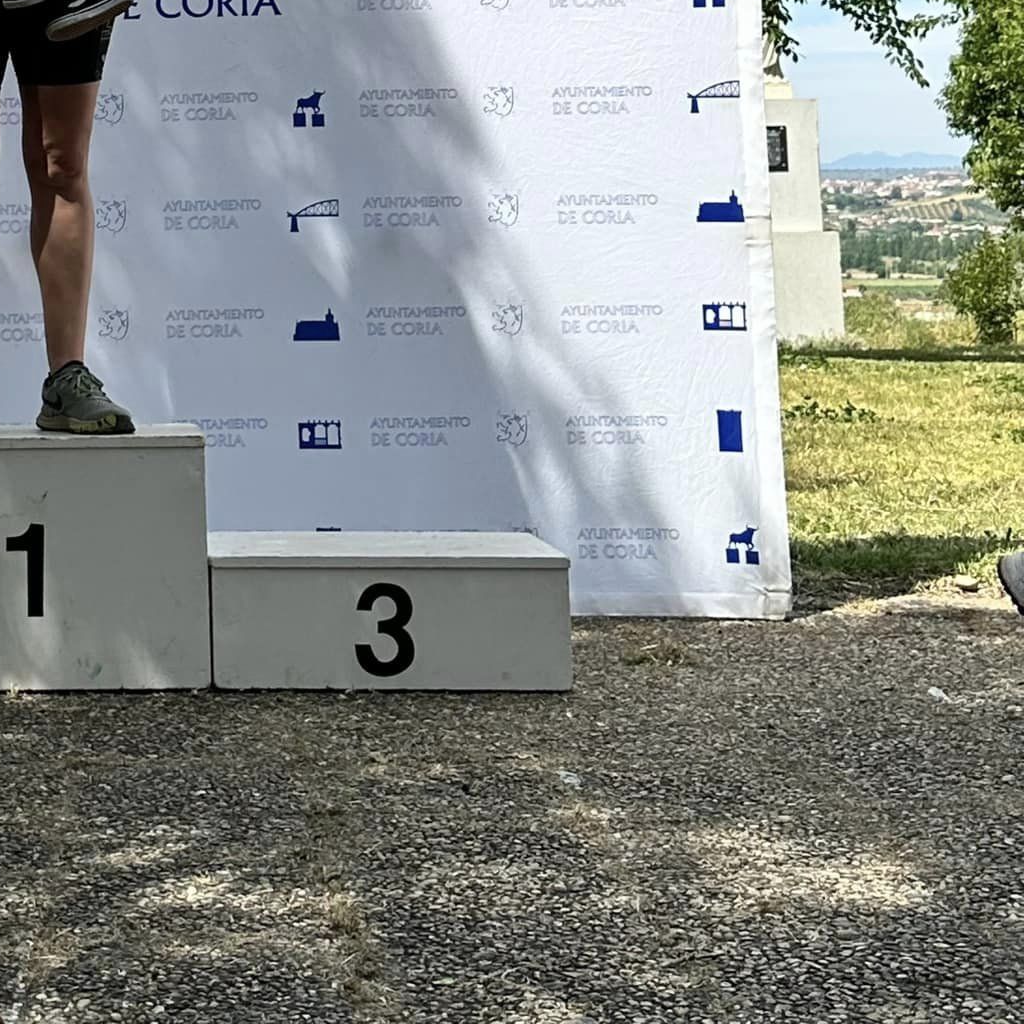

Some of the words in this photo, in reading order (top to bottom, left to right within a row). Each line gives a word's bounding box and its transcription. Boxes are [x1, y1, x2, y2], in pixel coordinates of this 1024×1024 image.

[160, 91, 259, 105] AYUNTAMIENTO
[358, 88, 458, 101] AYUNTAMIENTO
[551, 86, 653, 98] AYUNTAMIENTO
[160, 108, 180, 122] DE
[184, 107, 236, 121] CORIA
[359, 104, 379, 118] DE
[383, 104, 435, 117] CORIA
[552, 101, 572, 115] DE
[577, 100, 630, 114] CORIA
[162, 199, 262, 212] AYUNTAMIENTO
[362, 195, 462, 208] AYUNTAMIENTO
[556, 194, 659, 207] AYUNTAMIENTO
[163, 217, 183, 231] DE
[187, 216, 239, 230] CORIA
[363, 213, 383, 227] DE
[387, 212, 440, 226] CORIA
[557, 210, 577, 225] DE
[581, 210, 636, 224] CORIA
[165, 308, 265, 322] AYUNTAMIENTO
[366, 305, 467, 319] AYUNTAMIENTO
[560, 304, 663, 317] AYUNTAMIENTO
[166, 325, 186, 339] DE
[190, 324, 242, 338] CORIA
[367, 322, 386, 336] DE
[390, 322, 444, 336] CORIA
[561, 320, 581, 334] DE
[586, 319, 640, 333] CORIA
[0, 327, 42, 342] CORI
[369, 416, 471, 429] AYUNTAMIENTO
[565, 415, 668, 428] AYUNTAMIENTO
[204, 434, 246, 448] ORIA
[371, 433, 390, 447] DE
[395, 432, 448, 446] CORIA
[566, 431, 586, 445] DE
[591, 430, 645, 444] CORIA
[577, 527, 680, 541] AYUNTAMIENTO
[578, 544, 598, 559] DE
[603, 544, 657, 558] CORIA
[6, 524, 44, 617] 1
[355, 583, 414, 677] 3
